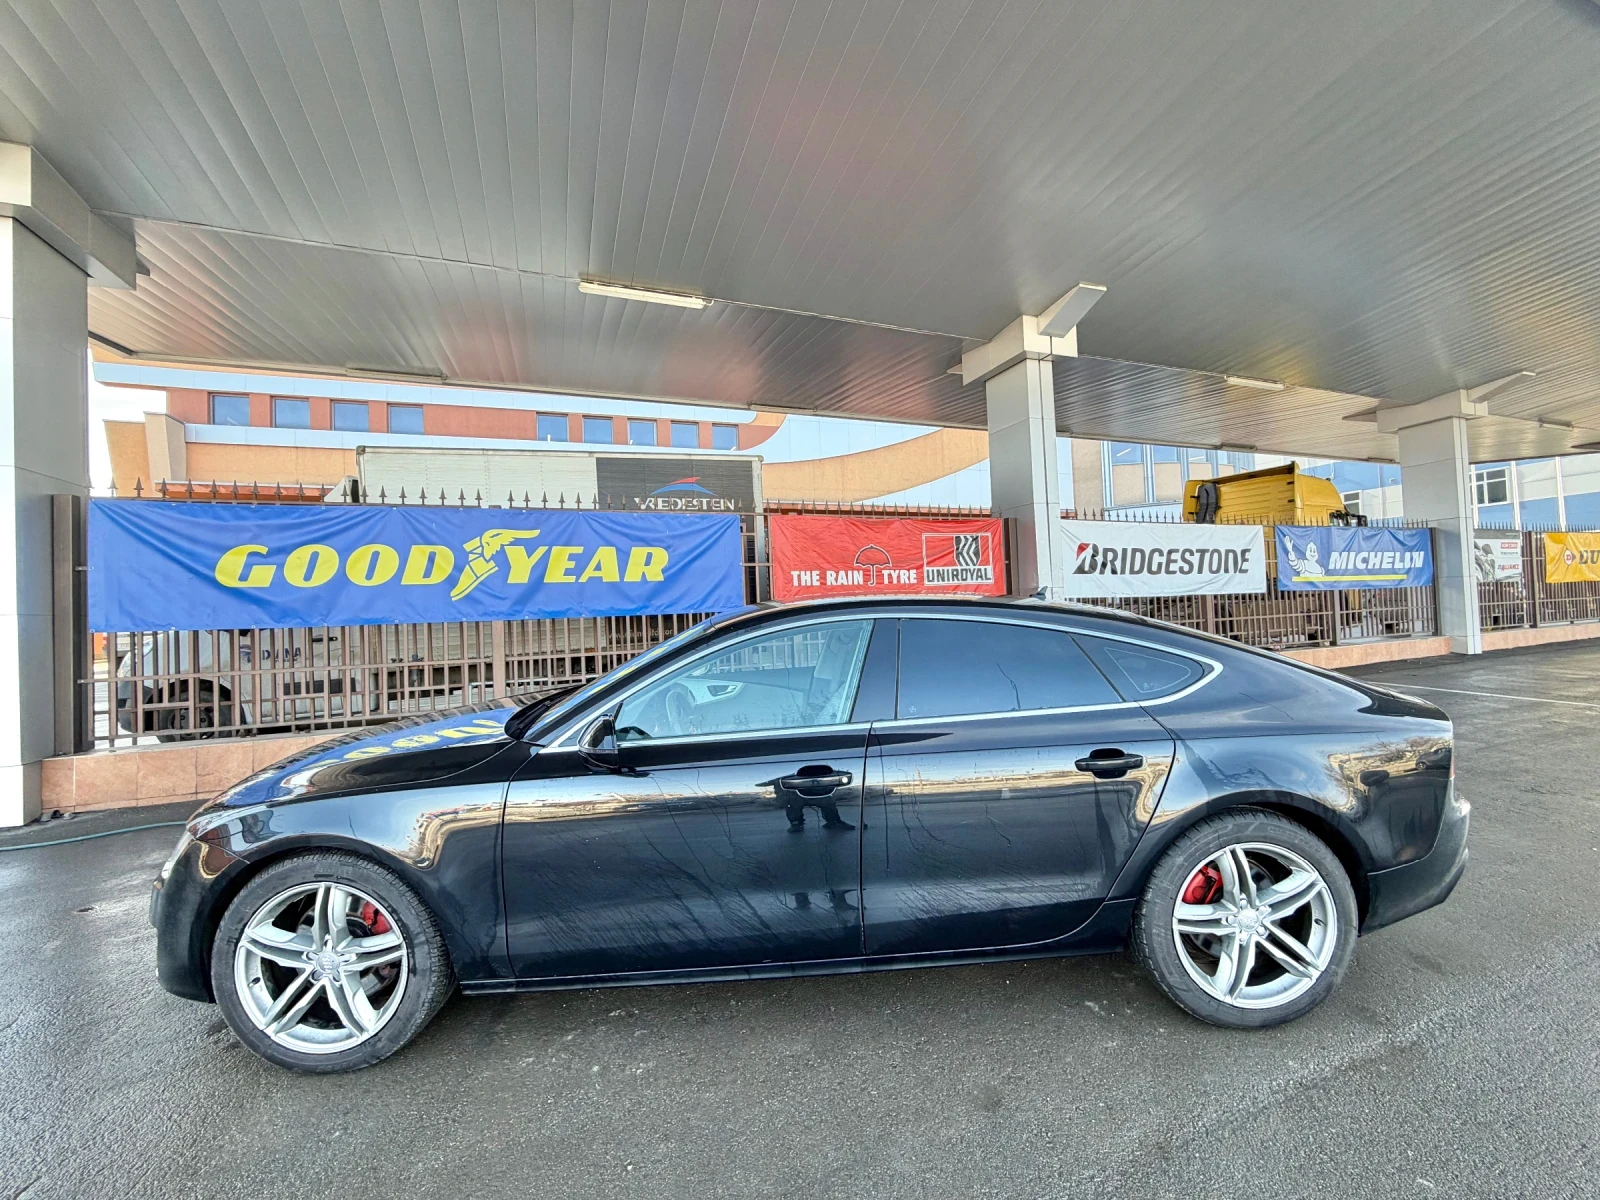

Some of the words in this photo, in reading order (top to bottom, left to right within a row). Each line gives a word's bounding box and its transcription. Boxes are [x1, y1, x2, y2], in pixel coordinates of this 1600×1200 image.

[634, 498, 735, 511] VREDESTEIN
[1072, 542, 1251, 576] BRIDGESTONE
[1328, 551, 1425, 571] MICHELIN
[790, 570, 820, 587] THE
[826, 569, 864, 586] RAIN
[881, 568, 917, 585] TYRE
[926, 567, 992, 583] UNIROYAL
[262, 647, 302, 660] DNA
